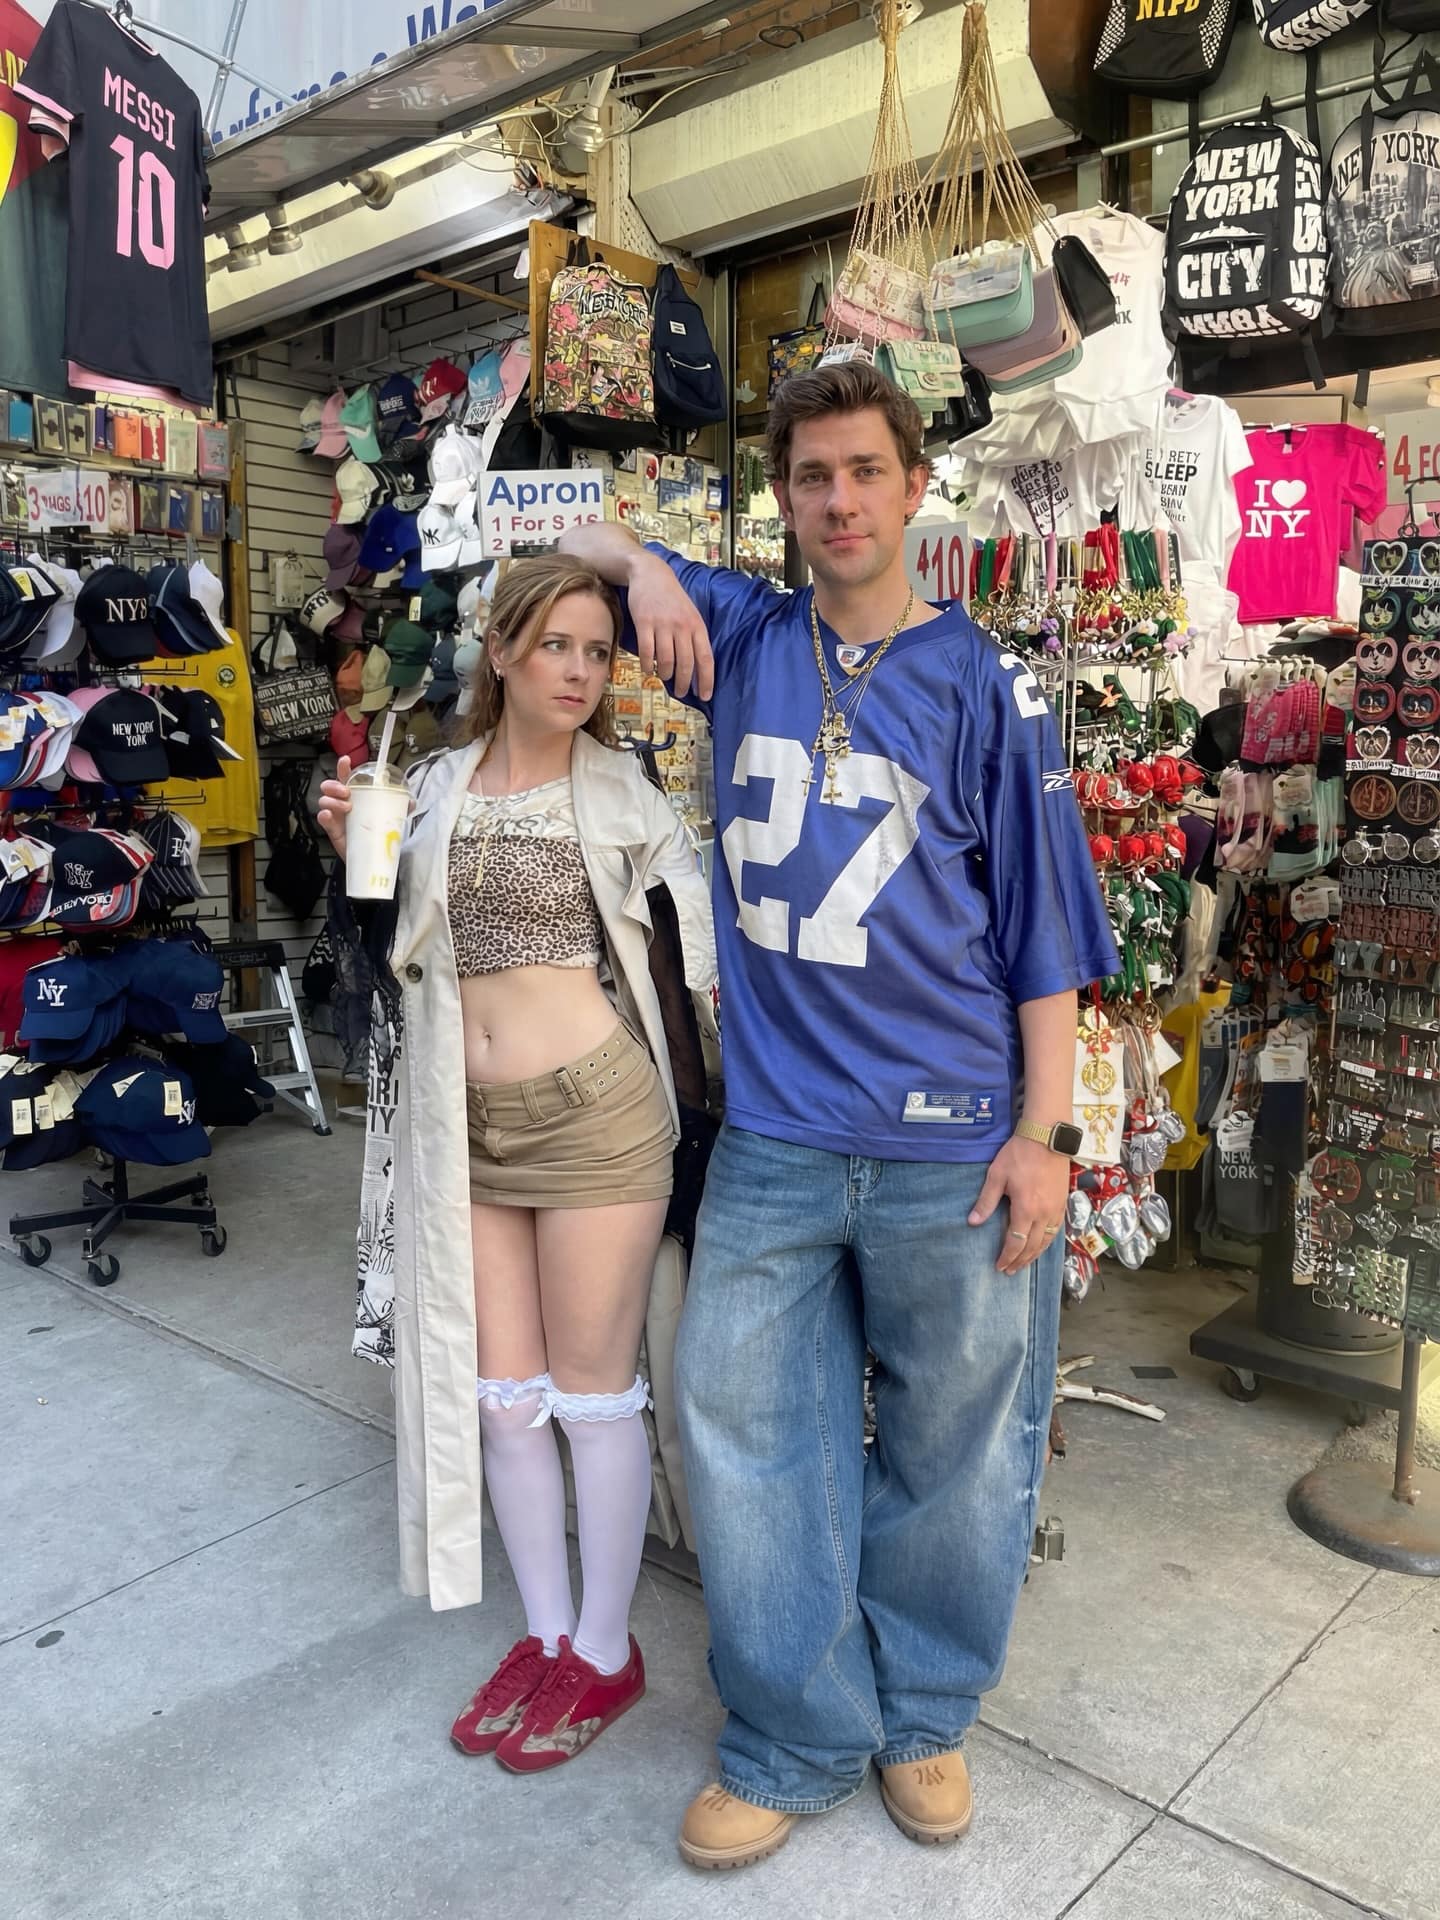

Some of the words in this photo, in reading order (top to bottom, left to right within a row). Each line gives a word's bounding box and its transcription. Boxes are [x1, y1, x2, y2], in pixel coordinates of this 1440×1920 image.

[103, 66, 176, 151] MESSI
[1192, 137, 1282, 184] NEW
[1382, 131, 1440, 169] YORK
[109, 134, 176, 271] 10
[1184, 174, 1280, 222] YORK
[1177, 245, 1265, 300] CITY
[1145, 460, 1197, 482] SLEEP
[1393, 434, 1411, 486] 4
[27, 486, 41, 522] 3
[487, 476, 600, 512] Apron
[1254, 479, 1272, 507] I
[511, 515, 546, 532] For
[1245, 509, 1311, 538] NY
[492, 538, 504, 551] 2
[270, 701, 300, 727] NEW
[302, 694, 335, 717] YORK
[112, 722, 132, 736] NEW
[722, 733, 932, 967] 27
[37, 978, 68, 1006] NY
[1219, 1164, 1258, 1180] YORK
